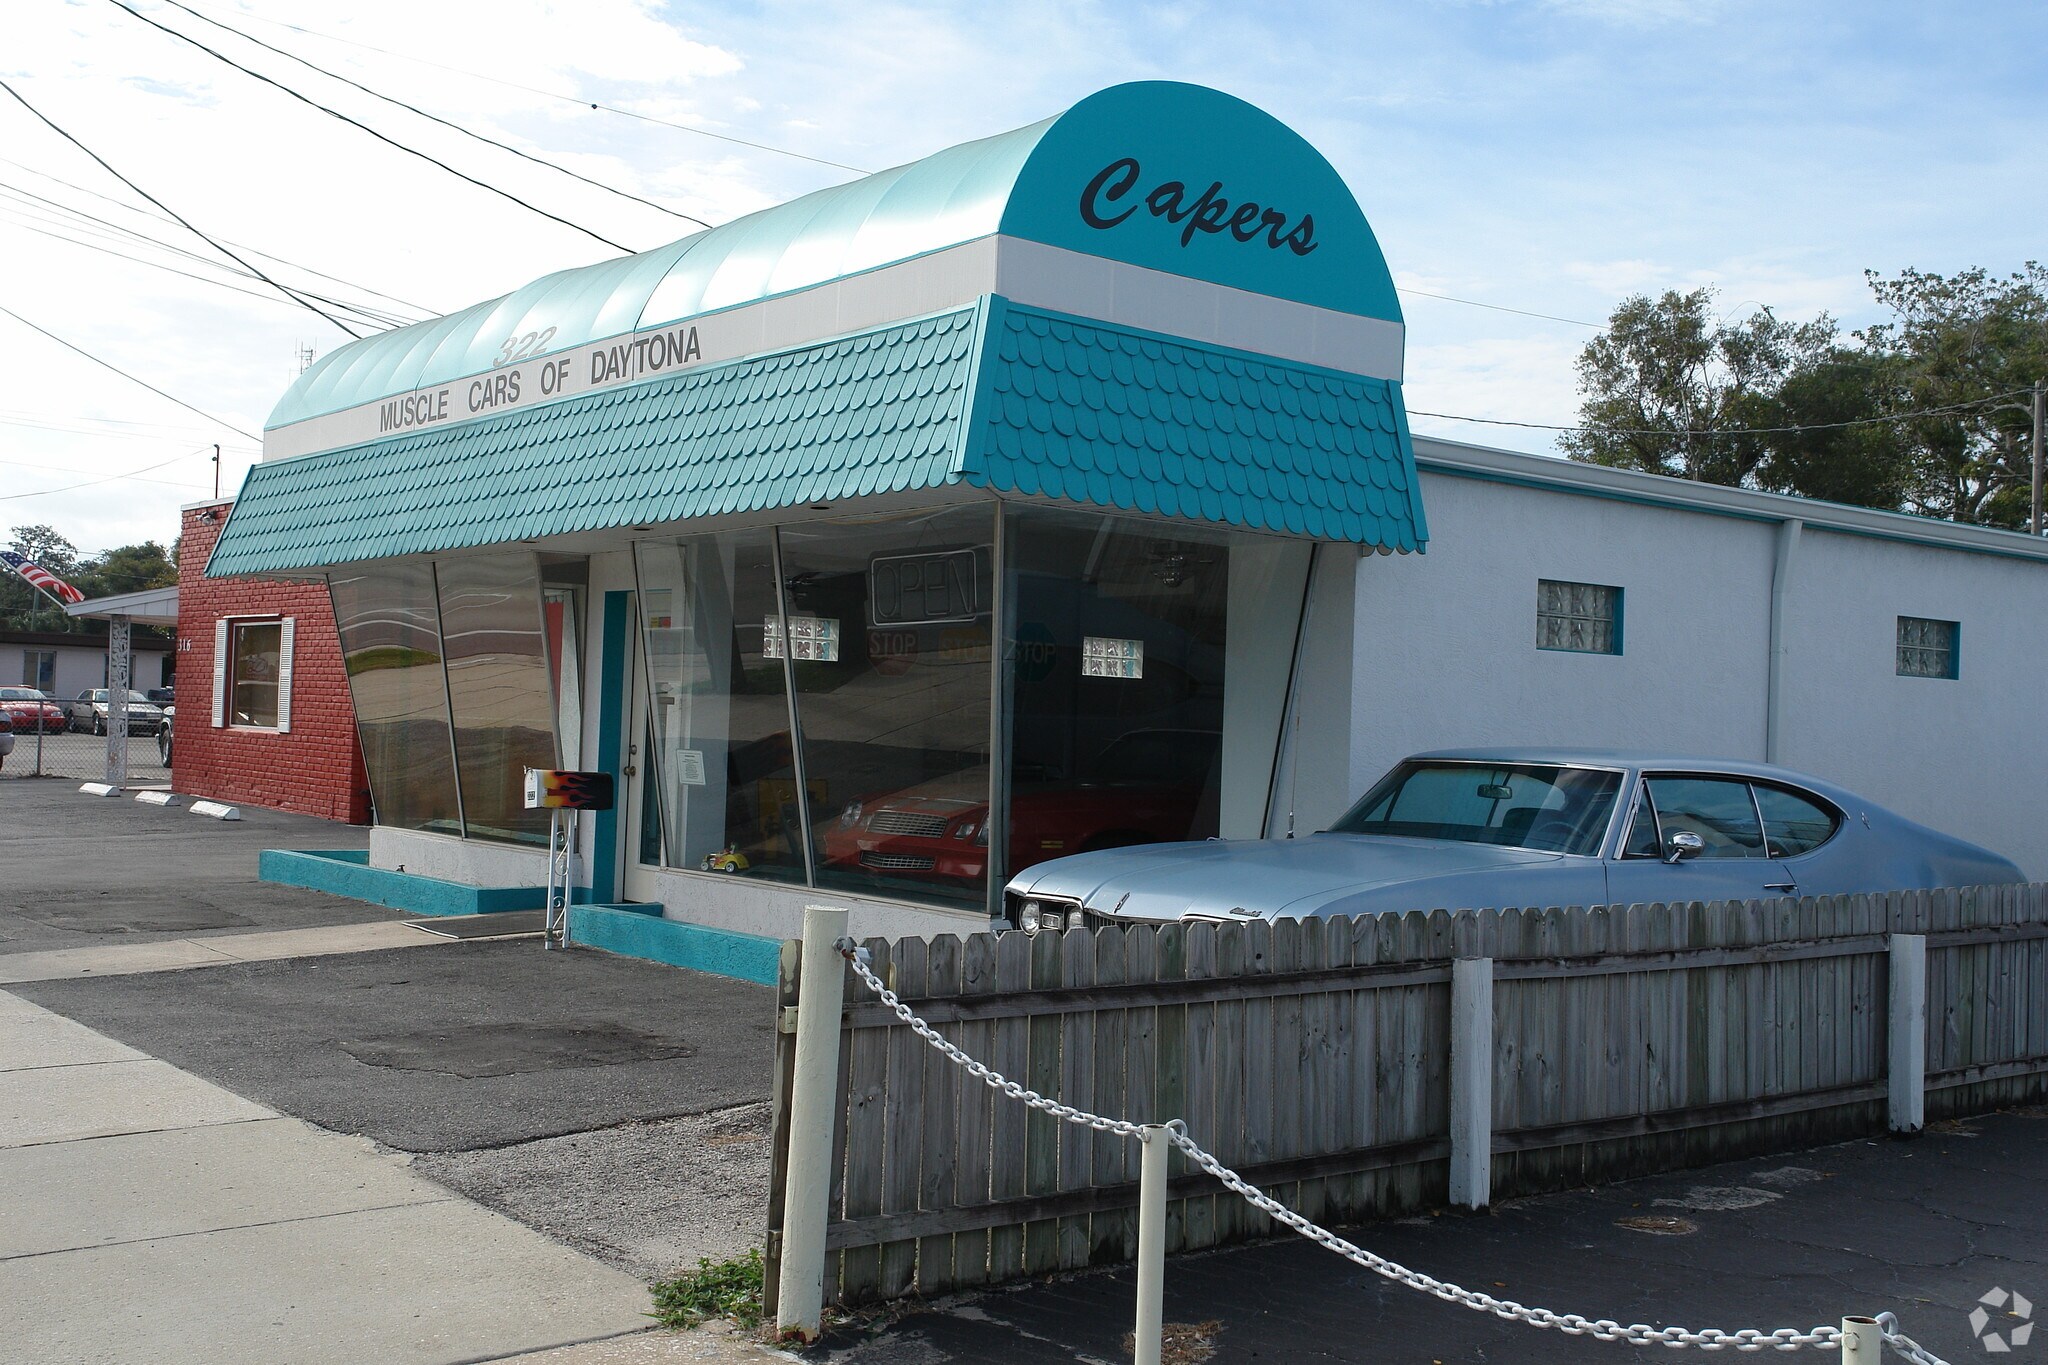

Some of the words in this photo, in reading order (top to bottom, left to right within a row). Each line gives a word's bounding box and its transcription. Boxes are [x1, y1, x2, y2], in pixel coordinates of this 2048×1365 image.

[1079, 157, 1318, 256] Capers
[492, 326, 558, 367] 322
[380, 389, 449, 433] MUSCLE
[468, 370, 521, 413] CARS
[540, 358, 571, 395] OF
[590, 326, 701, 385] DAYTONA
[876, 559, 971, 618] OPEN
[178, 639, 192, 652] 316
[870, 631, 916, 657] STOP
